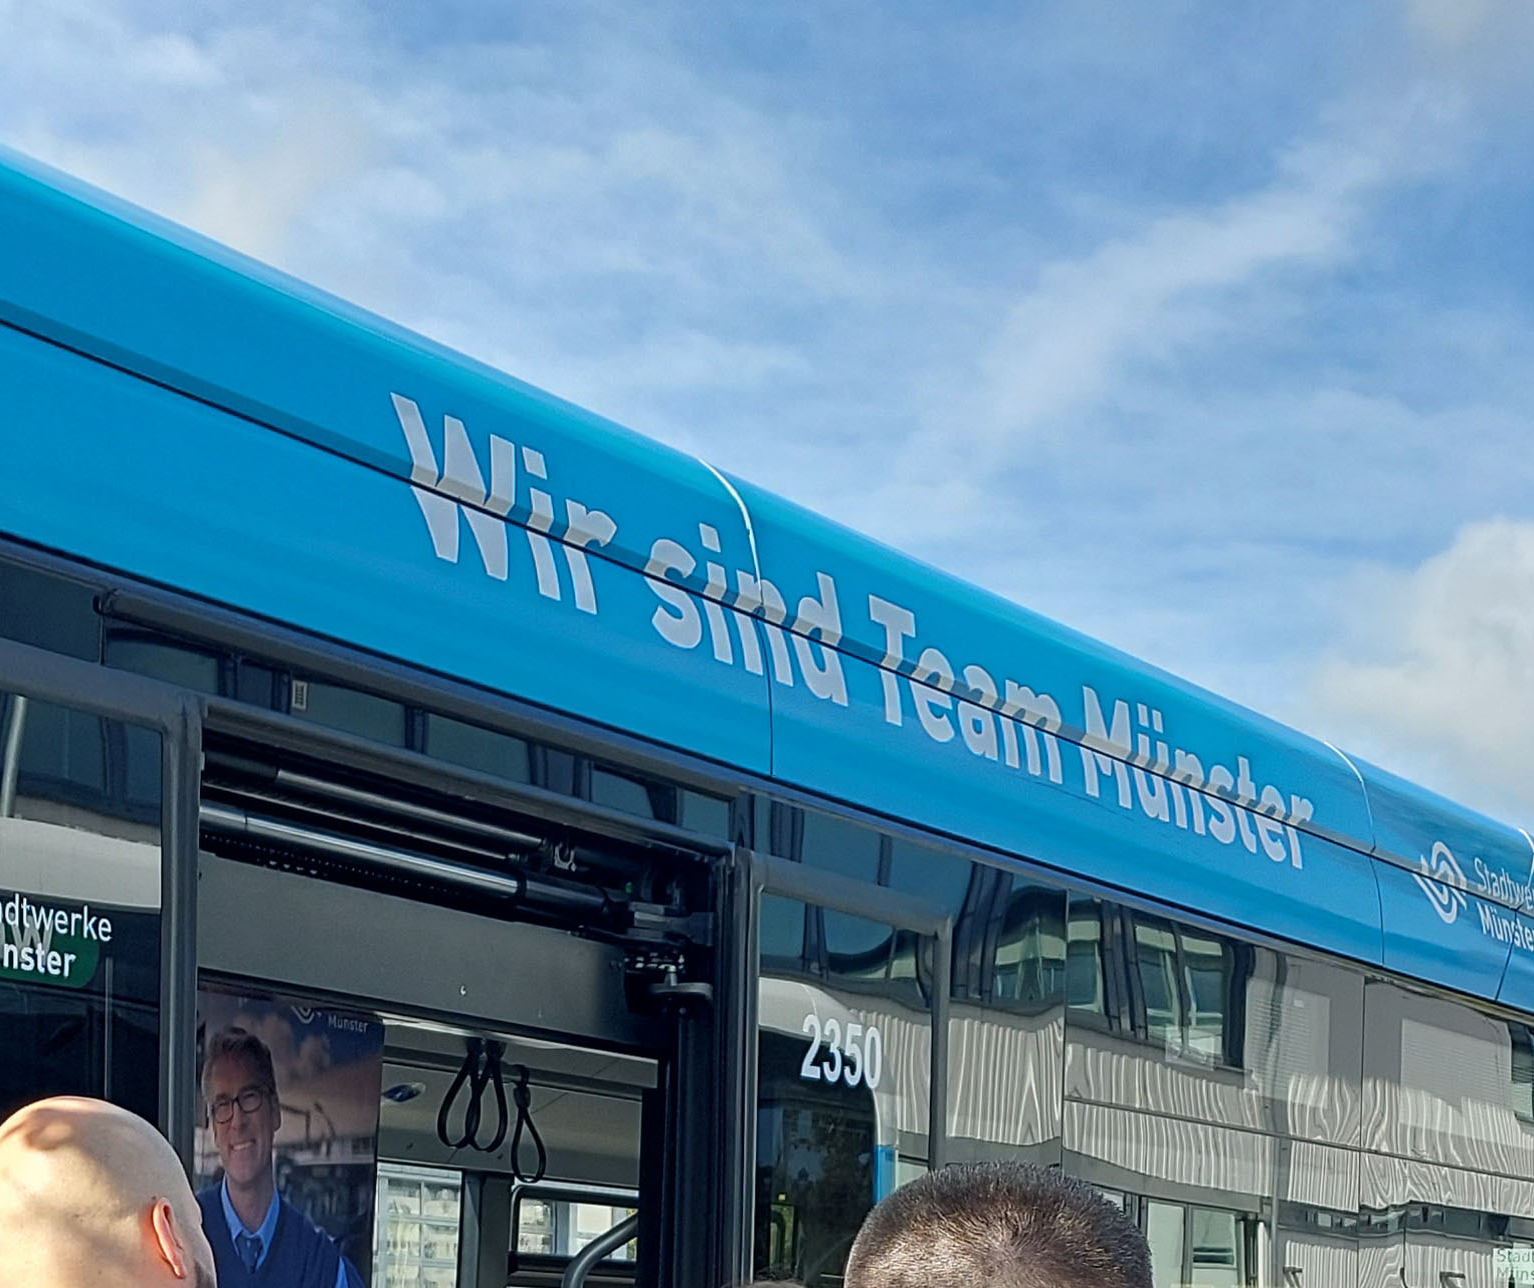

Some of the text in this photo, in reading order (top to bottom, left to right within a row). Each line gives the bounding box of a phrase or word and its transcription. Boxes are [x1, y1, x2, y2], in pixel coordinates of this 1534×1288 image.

[391, 392, 1317, 871] Wir sind Team Münster
[800, 1013, 882, 1089] 2350
